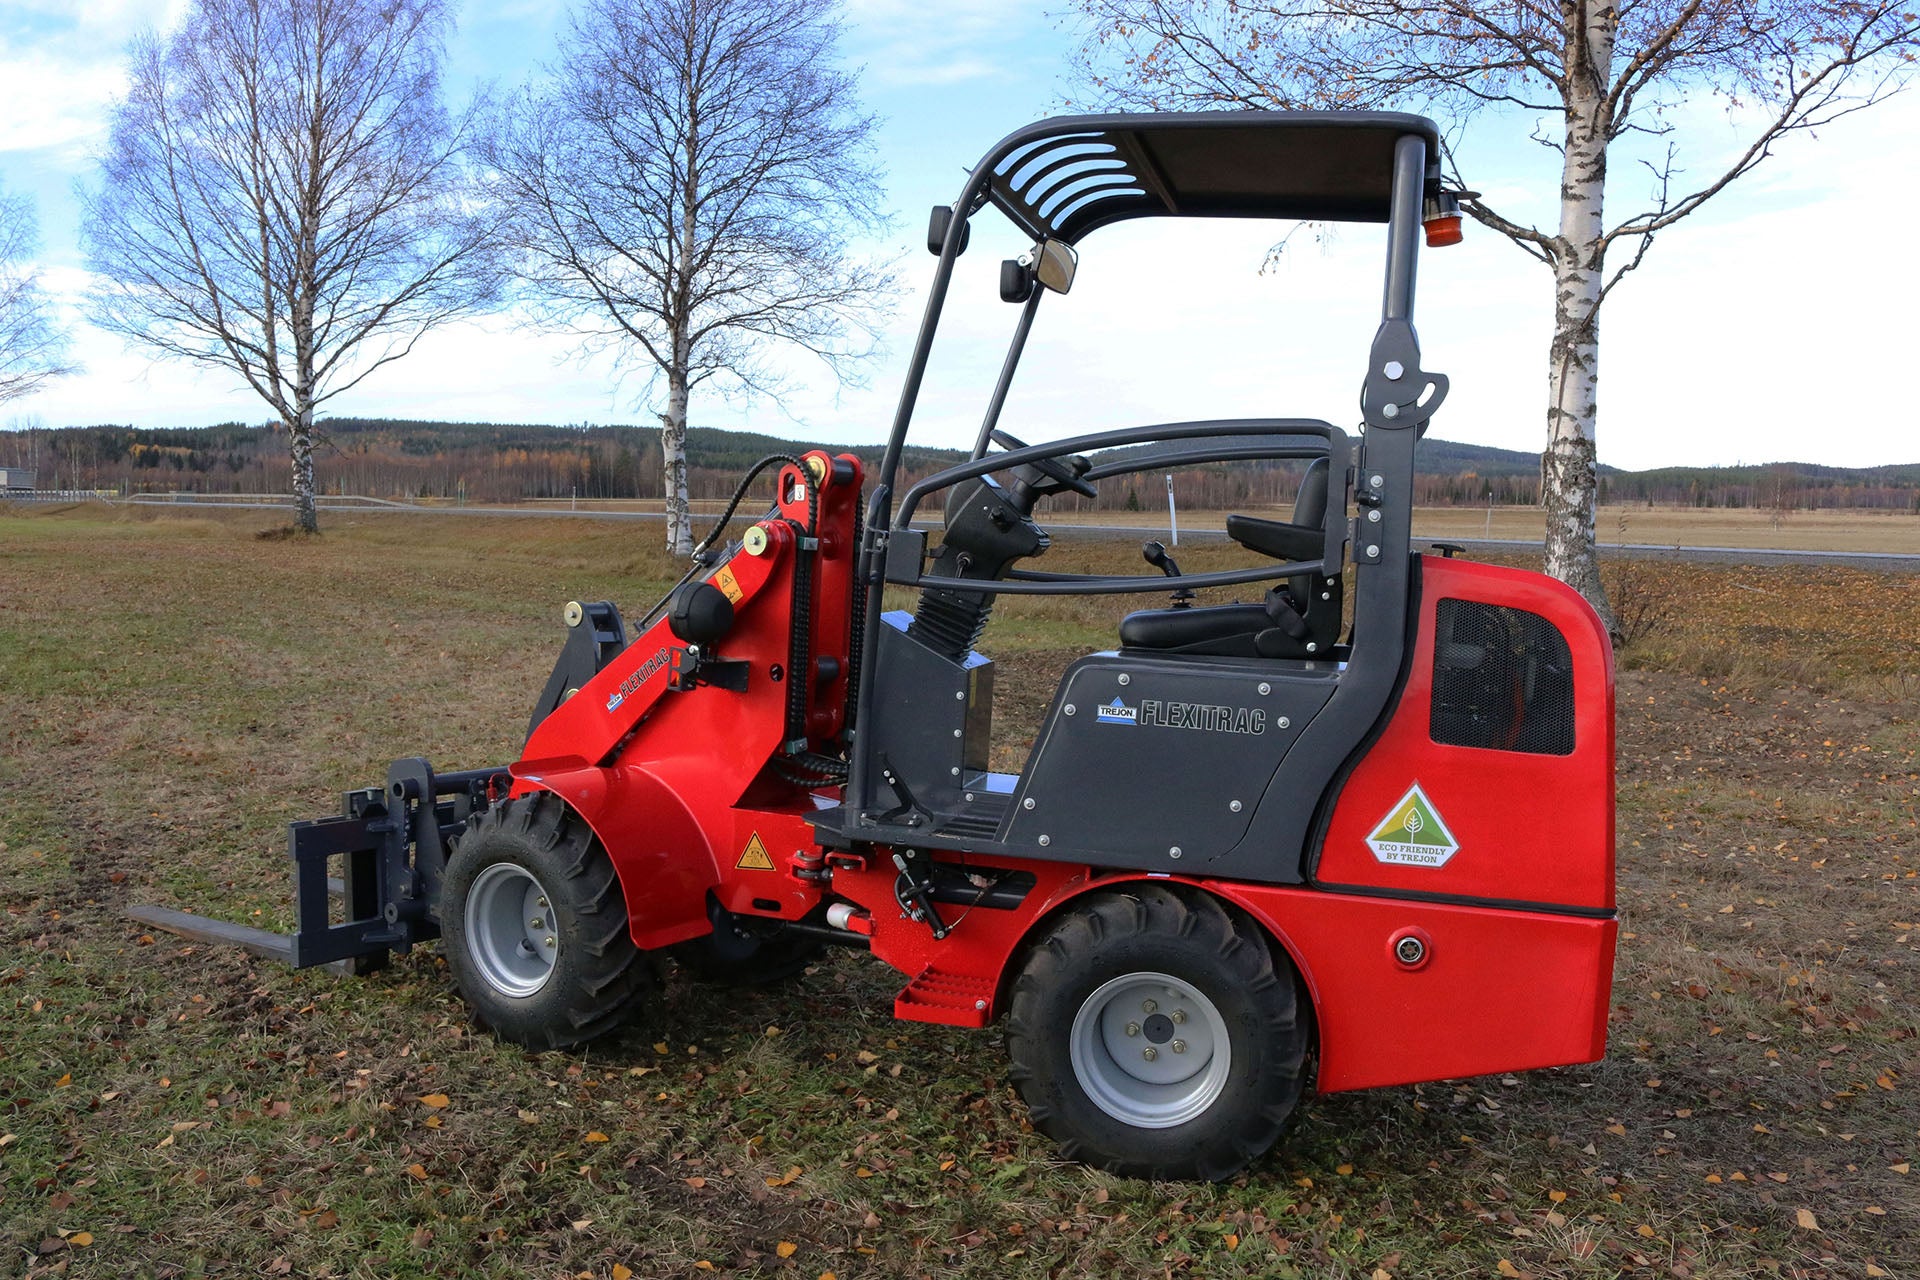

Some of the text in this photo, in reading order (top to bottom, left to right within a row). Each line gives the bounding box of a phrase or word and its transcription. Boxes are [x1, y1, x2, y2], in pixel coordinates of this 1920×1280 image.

[620, 648, 670, 698] FLEXITRAC
[1101, 700, 1266, 735] TREJON FLEXITRAC
[1379, 844, 1446, 855] ECO FRIENDLY
[1386, 852, 1437, 863] BY TREJON
